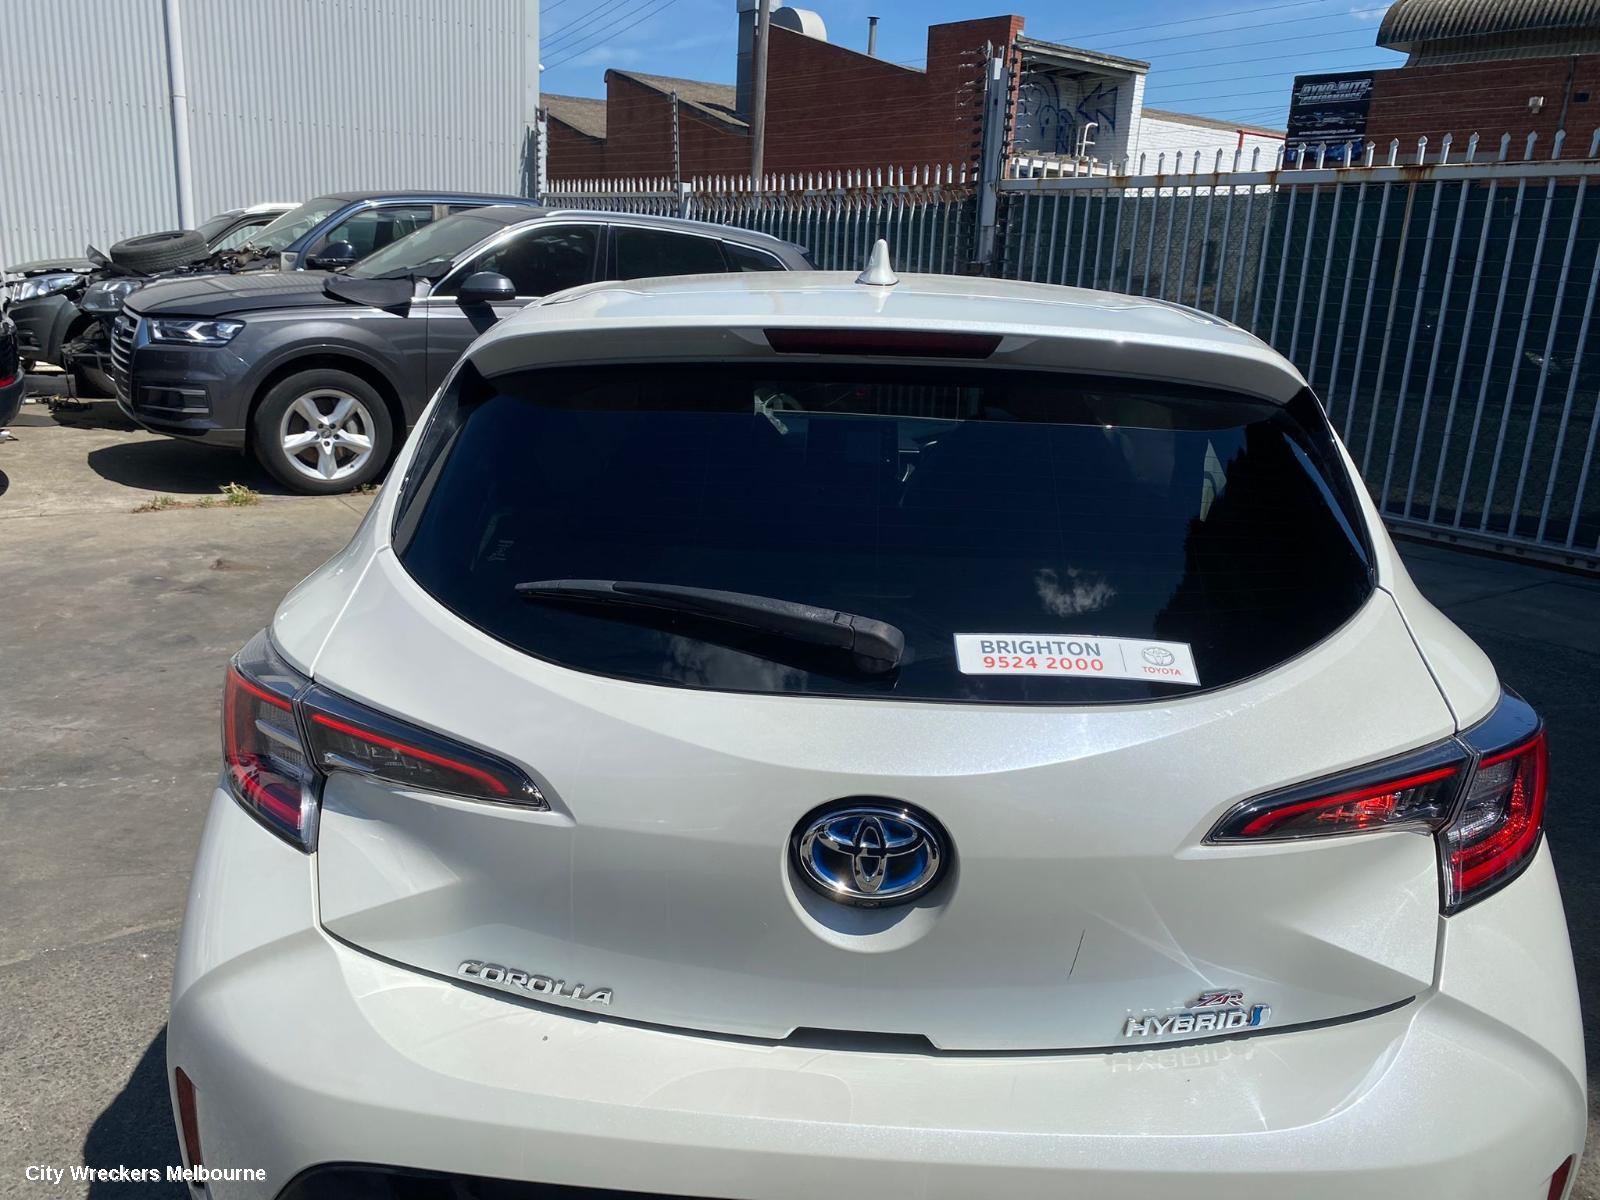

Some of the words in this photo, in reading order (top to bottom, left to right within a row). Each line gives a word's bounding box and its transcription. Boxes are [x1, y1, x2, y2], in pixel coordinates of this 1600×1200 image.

[980, 640, 1101, 657] BRIGHTON
[983, 656, 1038, 668] 9524
[1046, 657, 1104, 671] 2000
[1143, 666, 1182, 676] TOYOTA
[457, 960, 614, 1007] COROLLA
[1188, 990, 1244, 1008] ZR
[1125, 1009, 1248, 1037] HYBRID
